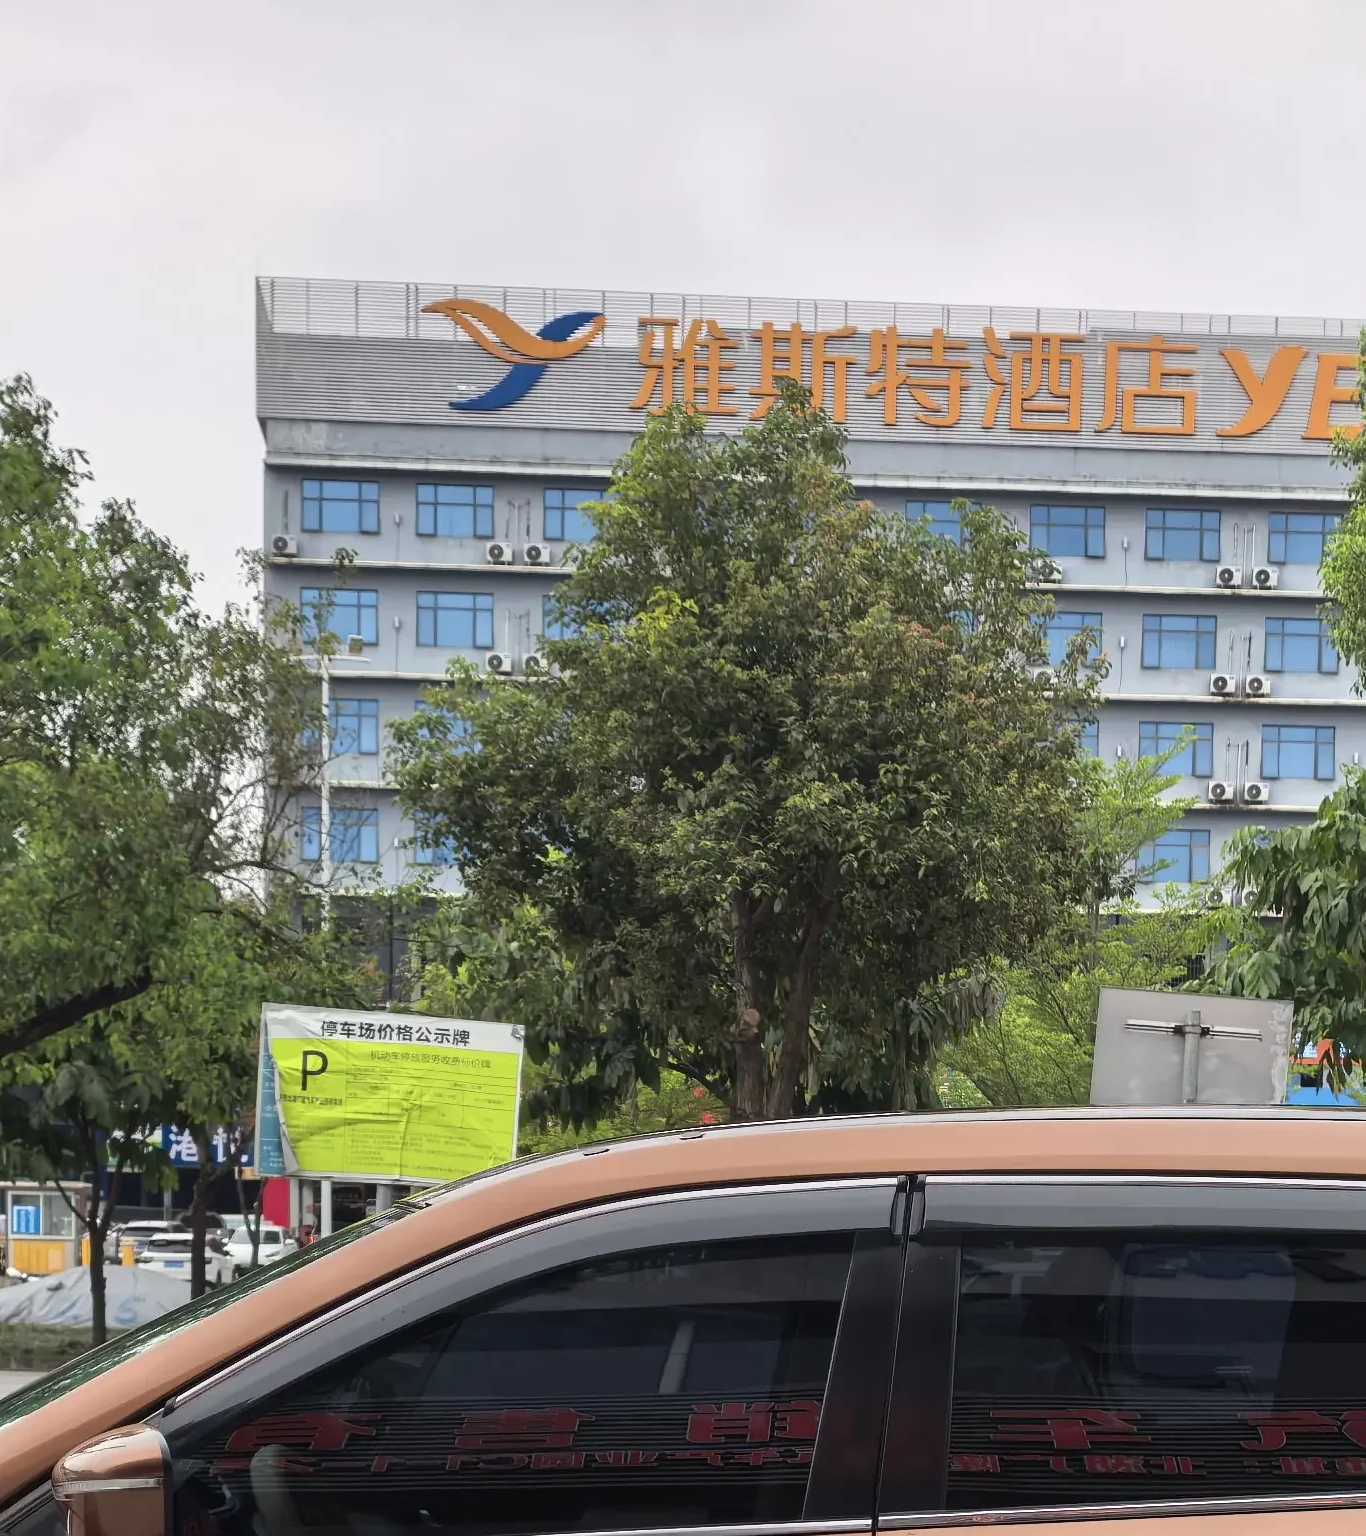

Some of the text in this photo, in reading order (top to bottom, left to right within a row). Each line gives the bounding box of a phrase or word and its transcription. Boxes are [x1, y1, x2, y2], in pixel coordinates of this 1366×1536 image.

[629, 317, 1199, 436] 雅斯特酒店
[320, 1020, 471, 1047] 停车场价格公示牌
[300, 1049, 329, 1092] P
